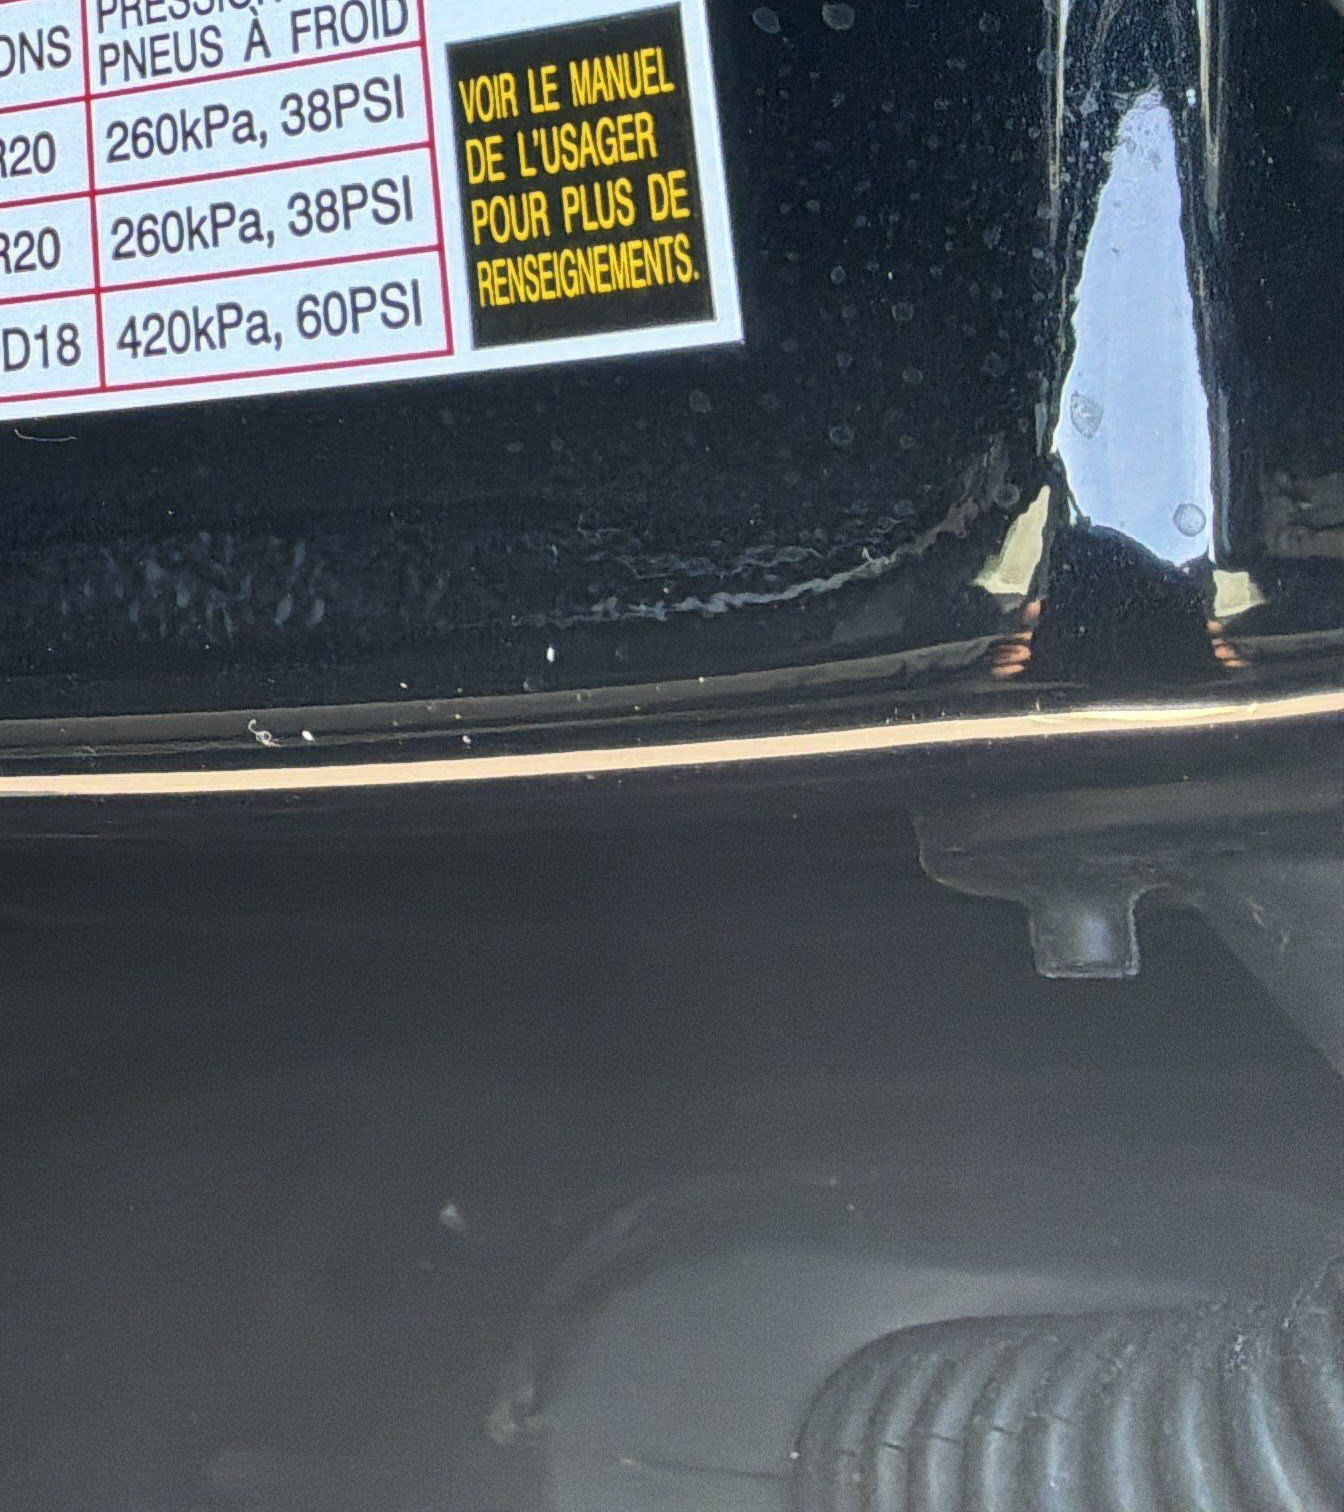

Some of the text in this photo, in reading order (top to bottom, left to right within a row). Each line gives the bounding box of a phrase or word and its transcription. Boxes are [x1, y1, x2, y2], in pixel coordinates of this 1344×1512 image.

[98, 24, 223, 86] PNEUS
[243, 5, 271, 62] À
[457, 46, 675, 123] VOIR LE MANUEL
[105, 73, 404, 163] 260kPa, 38PSI
[464, 110, 657, 184] DE L'USAGER
[110, 174, 413, 261] 260kPa, 38PSI
[470, 168, 690, 245] POUR PLUS DE
[476, 232, 699, 307] RENSEIGNEMENTS.
[116, 278, 422, 358] 420kPa, 60PSI
